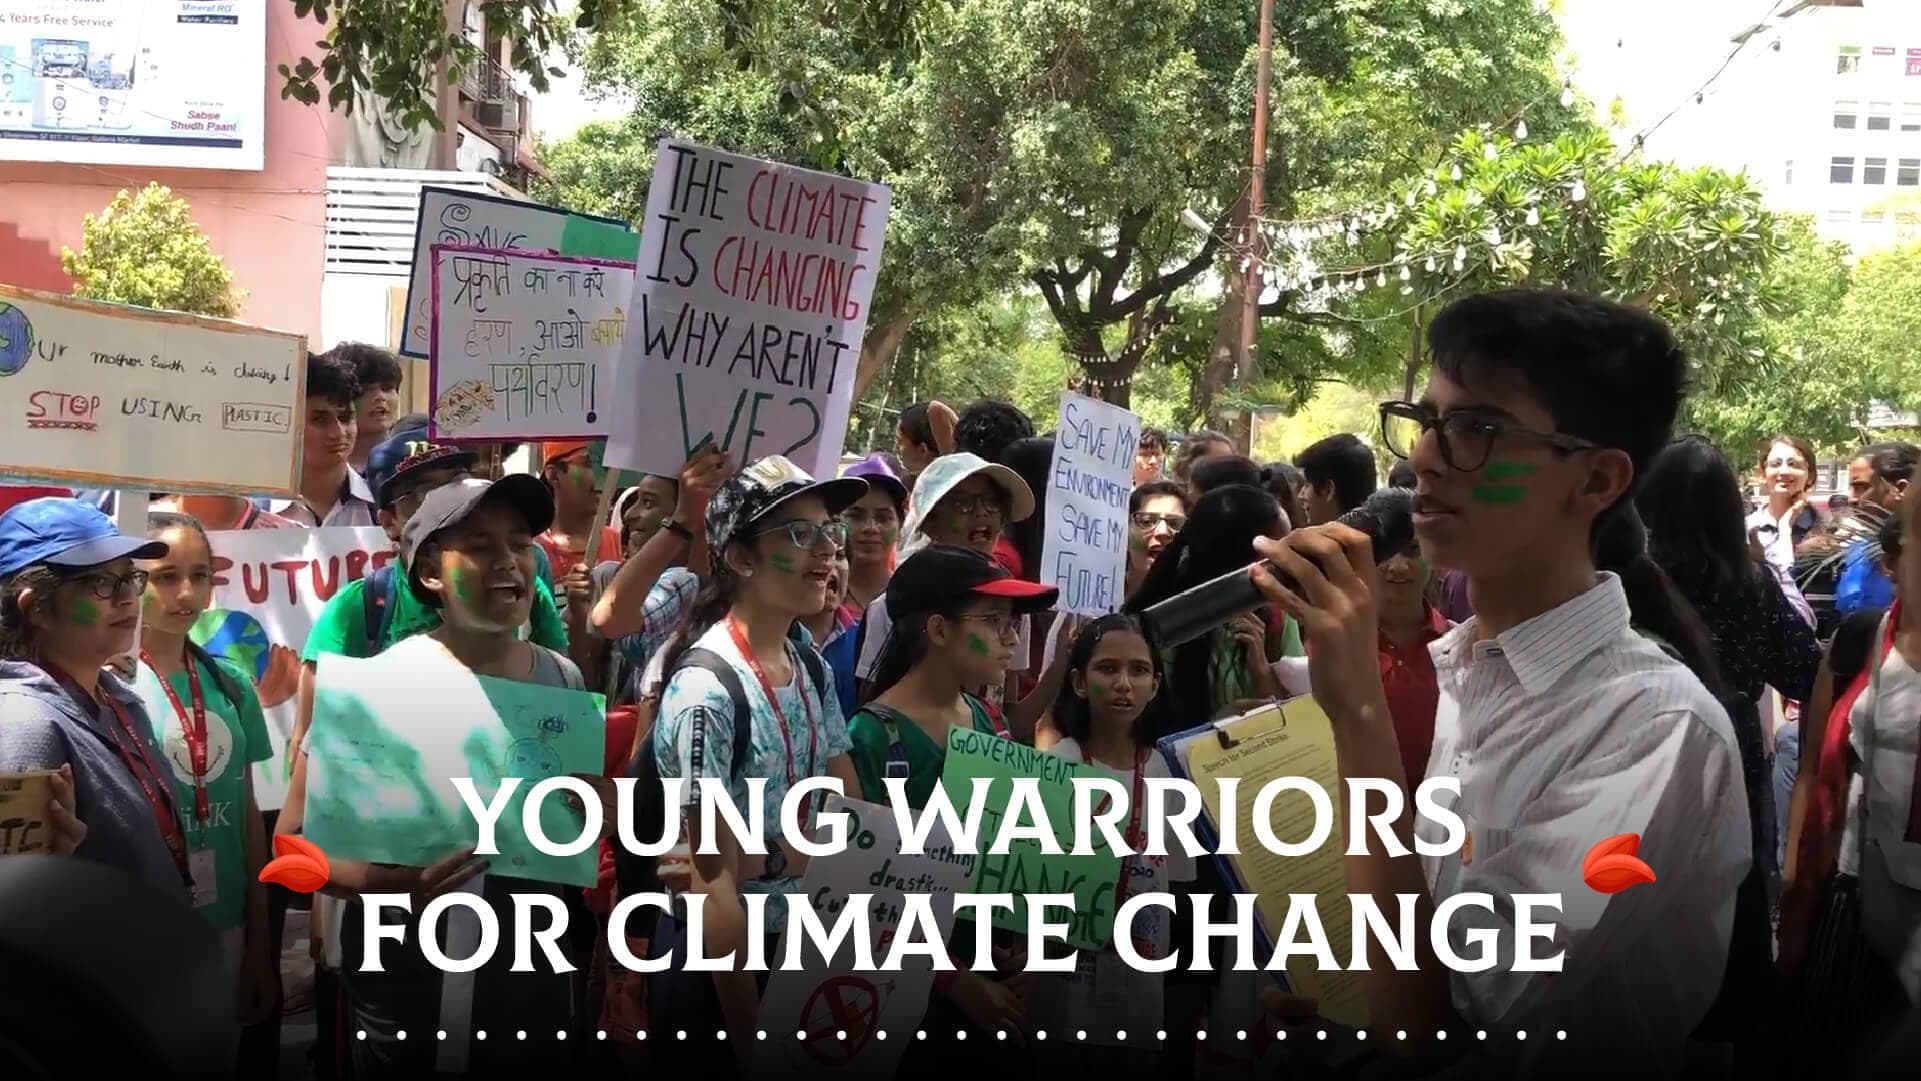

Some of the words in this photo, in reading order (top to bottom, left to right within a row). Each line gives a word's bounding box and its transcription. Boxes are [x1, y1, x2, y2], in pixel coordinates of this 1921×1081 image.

[9, 12, 41, 25] Years
[43, 13, 69, 25] Free
[71, 15, 114, 27] Service
[171, 120, 204, 131] Shudh
[205, 121, 237, 132] Paani
[188, 110, 221, 120] Sabse
[667, 145, 734, 221] THE
[748, 170, 877, 252] CLIMATE
[646, 214, 702, 288] IS
[714, 235, 866, 321] CHANGING
[642, 293, 730, 368] WHY
[728, 321, 850, 395] AREN'T
[26, 390, 101, 420] STOP
[121, 396, 201, 425] USING
[1061, 403, 1113, 461] SAVE
[1112, 423, 1138, 471] MY
[1055, 456, 1131, 509] ENVIRONMENT
[1059, 503, 1103, 548] SAVE
[1106, 516, 1124, 553] MY
[1056, 551, 1117, 614] FUTURE!
[950, 727, 1079, 787] GOVERNMENT
